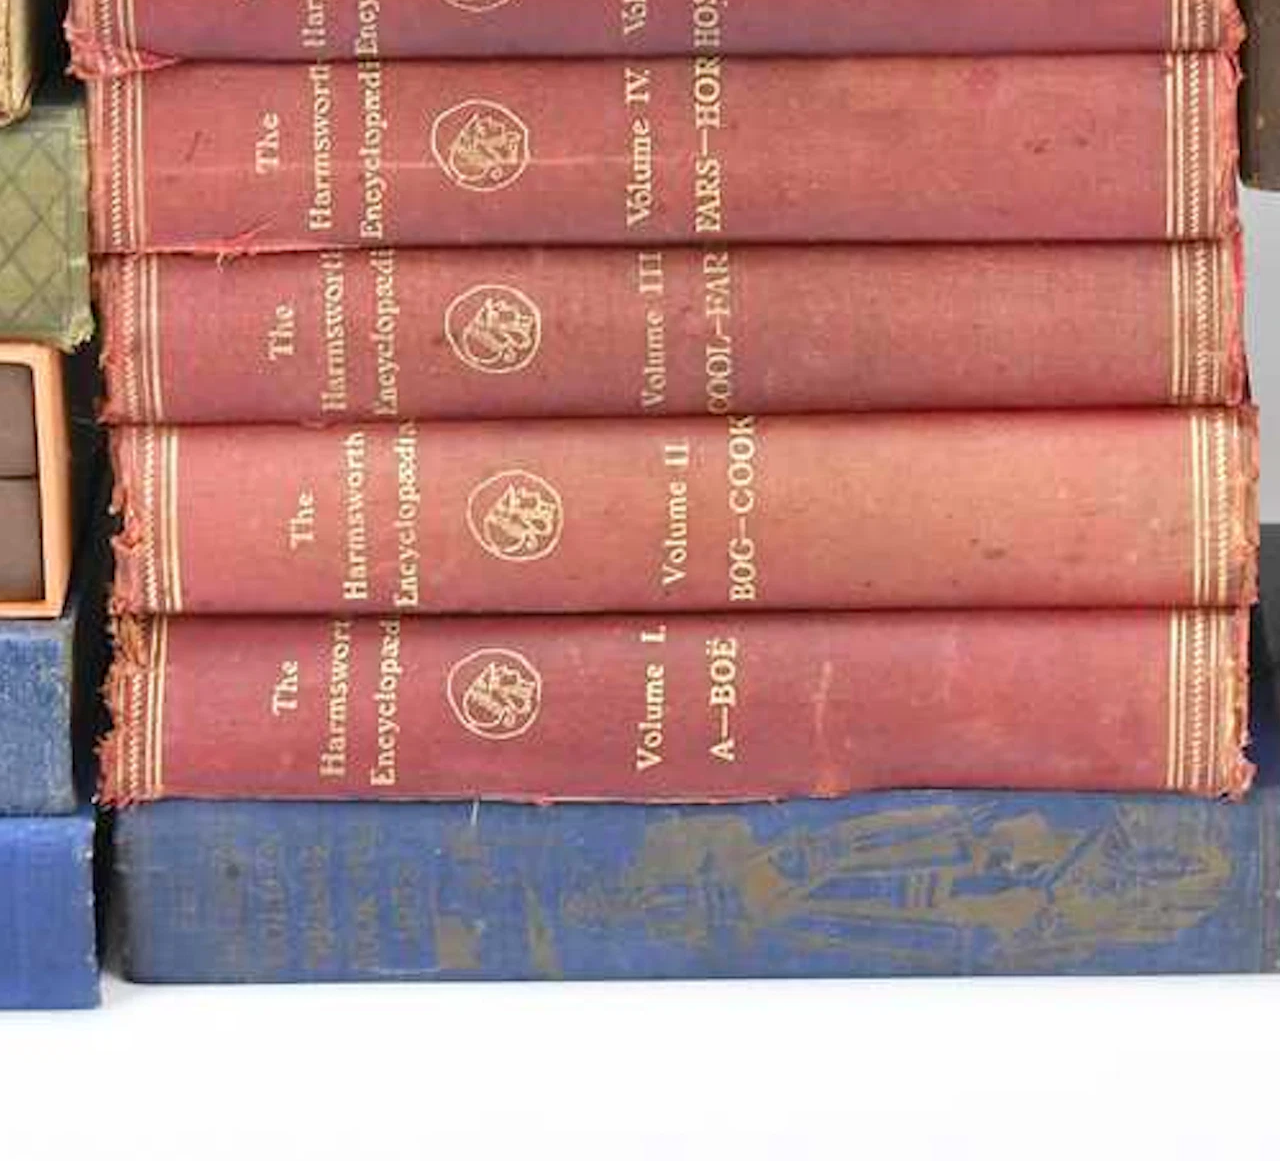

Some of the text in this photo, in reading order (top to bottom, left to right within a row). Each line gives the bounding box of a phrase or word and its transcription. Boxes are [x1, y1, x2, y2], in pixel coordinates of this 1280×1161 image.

[254, 112, 281, 174] The
[625, 118, 653, 227] Volume
[267, 303, 295, 361] The
[640, 309, 667, 409] Volume
[289, 489, 316, 552] The
[341, 430, 368, 600] Harmsworth
[661, 480, 688, 587] Volume
[271, 659, 300, 716] The
[635, 663, 665, 772] Volume
